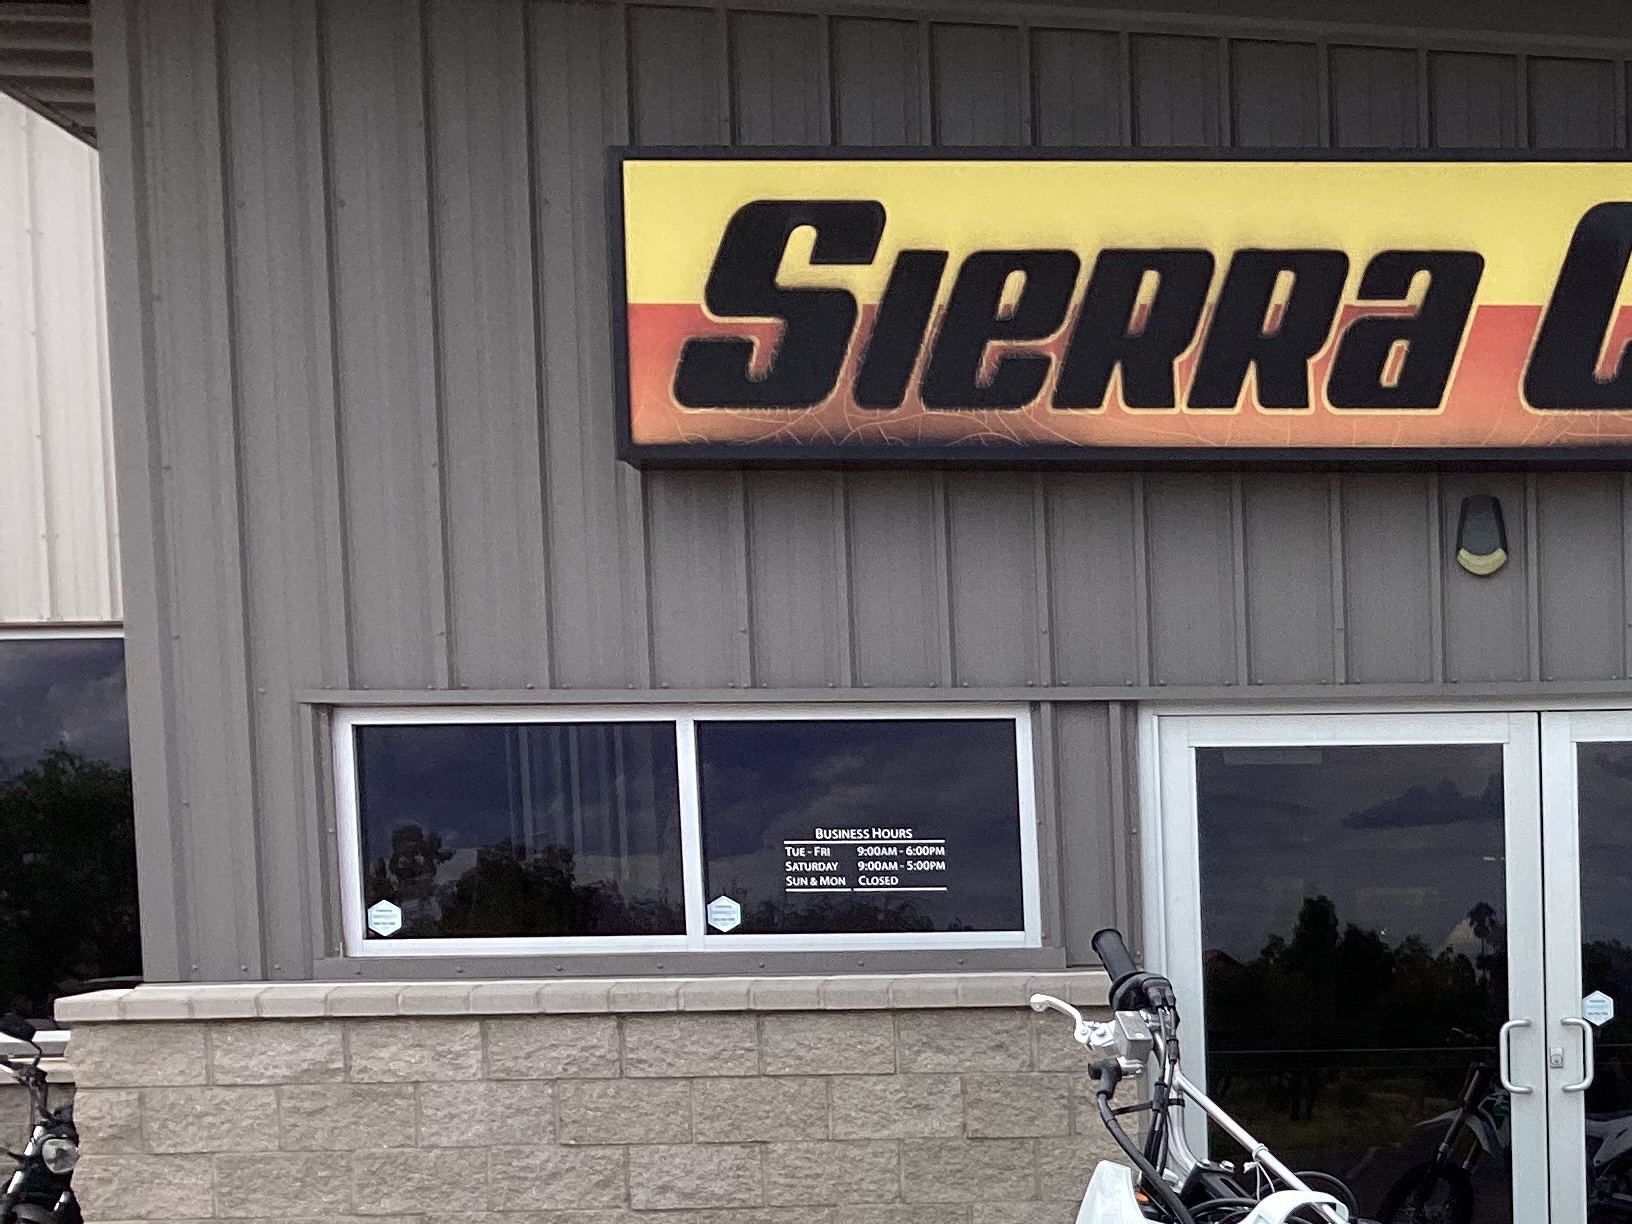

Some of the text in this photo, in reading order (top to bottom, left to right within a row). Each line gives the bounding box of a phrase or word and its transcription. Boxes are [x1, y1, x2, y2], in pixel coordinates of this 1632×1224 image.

[815, 827, 913, 840] BUSINESS HOURS
[785, 846, 806, 857] TUE
[814, 846, 831, 857] FRI
[857, 846, 898, 857] 9:00AM
[905, 846, 945, 856] 6:00PM
[785, 861, 839, 872] SATURDAY
[857, 861, 898, 872] 9:00AM
[906, 861, 946, 871] 5:00PM
[785, 875, 899, 887] SUN & MON CLOSED
